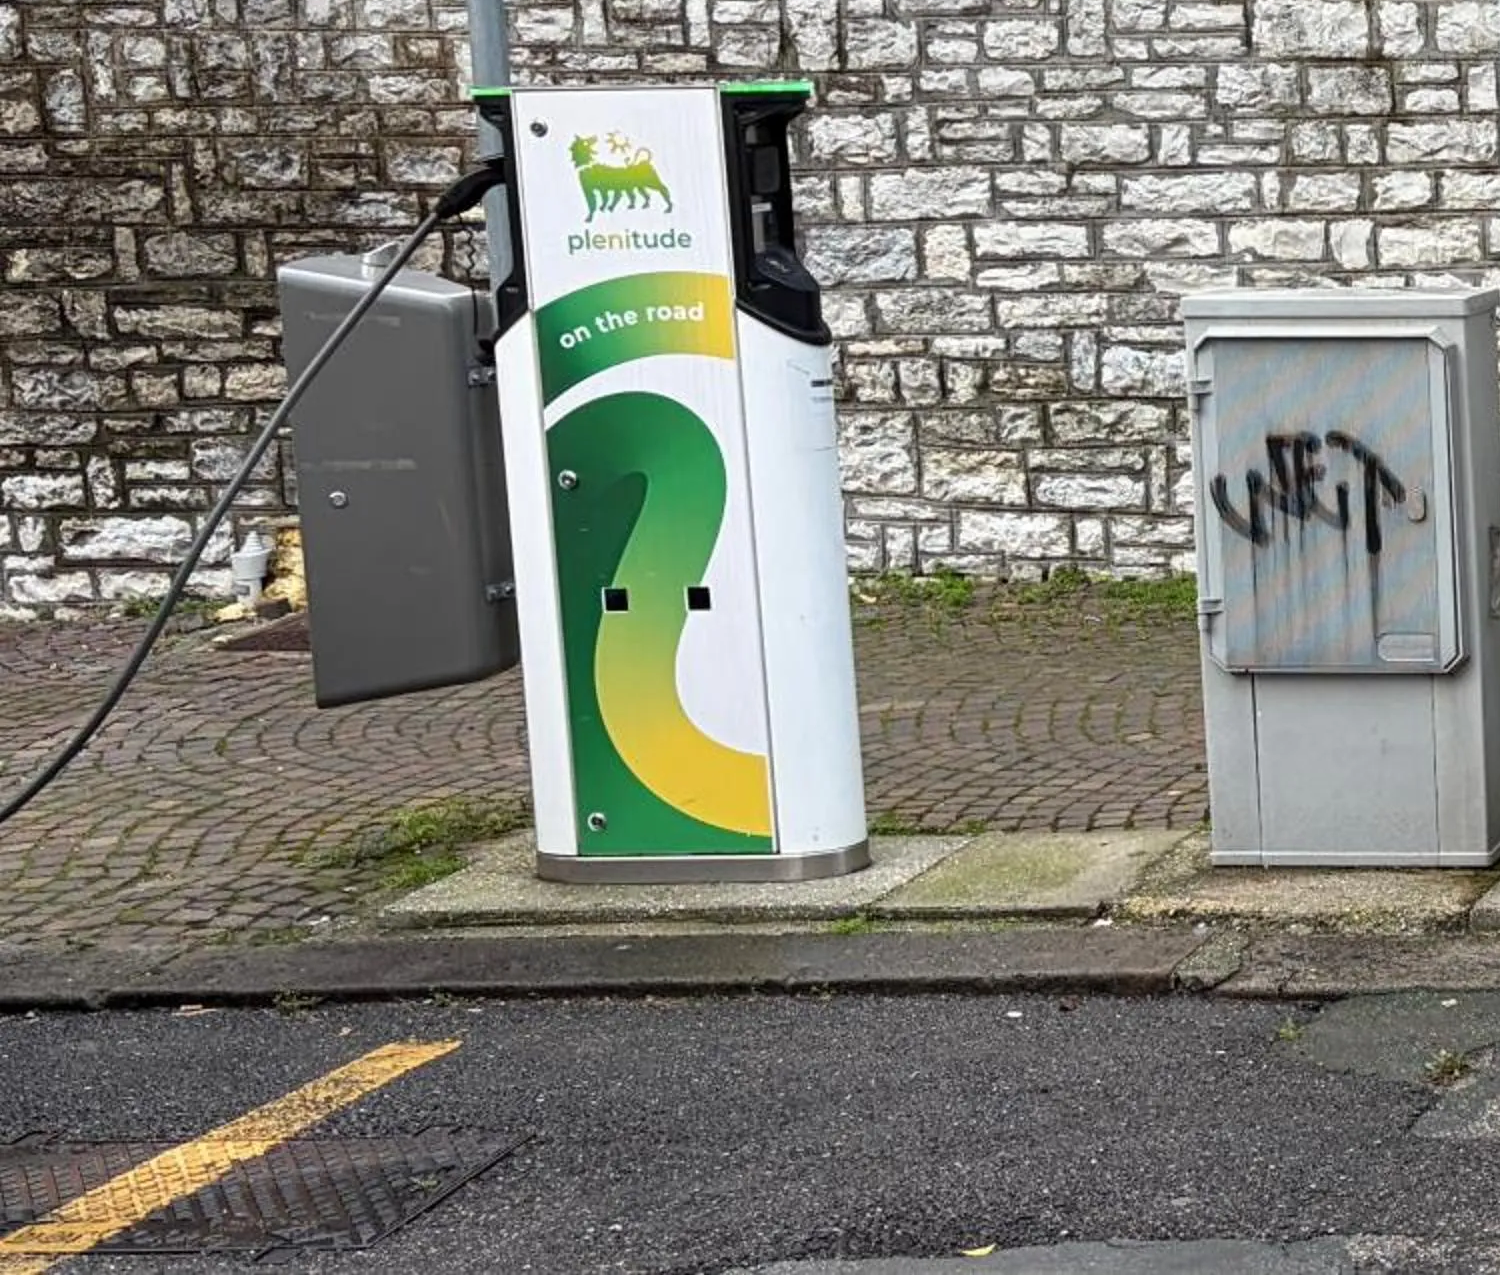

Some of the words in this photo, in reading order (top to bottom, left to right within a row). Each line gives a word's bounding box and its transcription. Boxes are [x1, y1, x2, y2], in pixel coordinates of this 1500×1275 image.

[567, 228, 692, 255] plenitude
[559, 325, 592, 349] on
[595, 308, 639, 334] the
[646, 301, 705, 323] road
